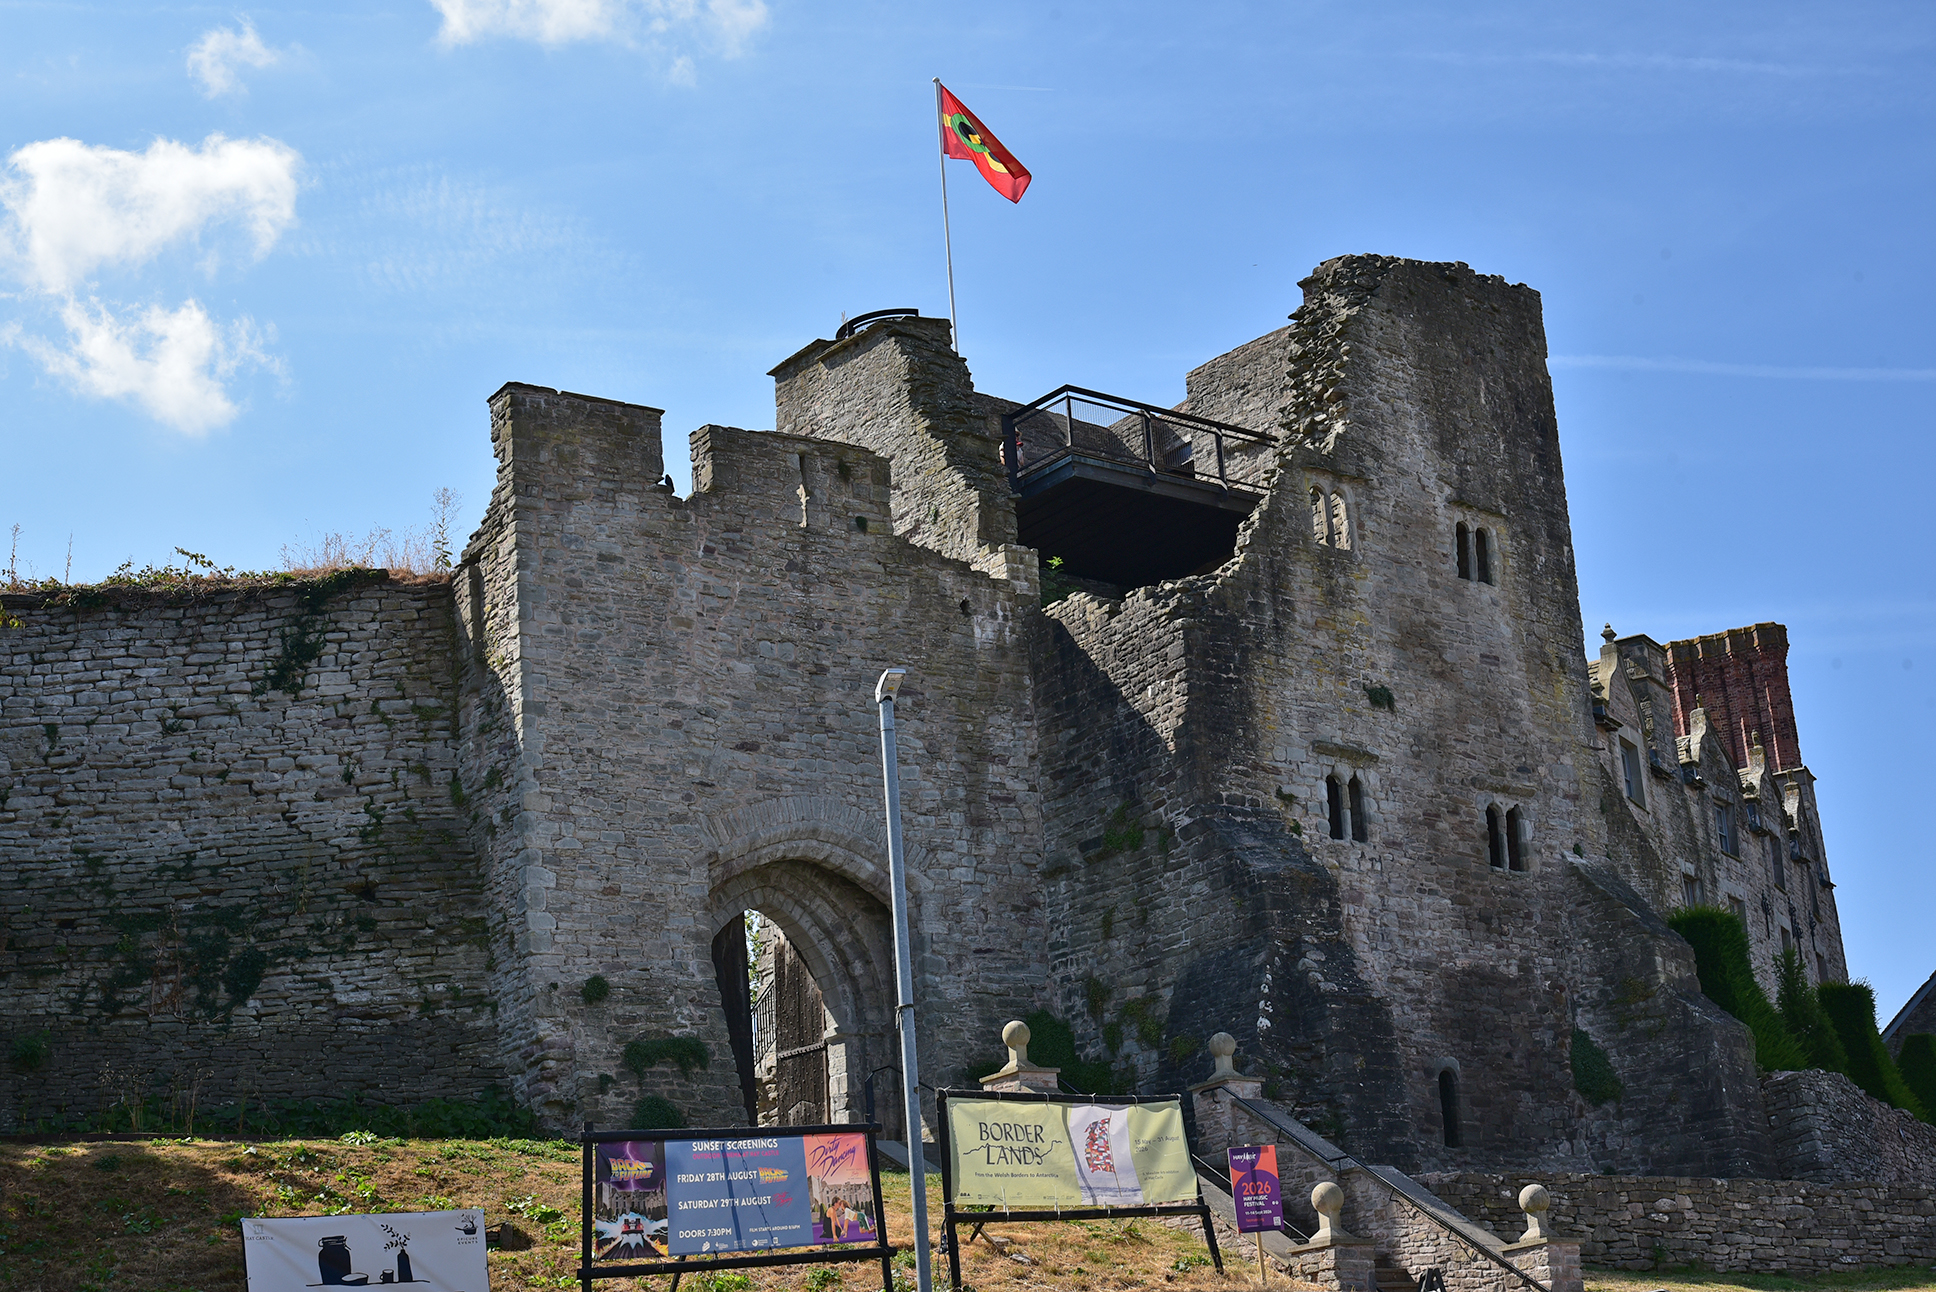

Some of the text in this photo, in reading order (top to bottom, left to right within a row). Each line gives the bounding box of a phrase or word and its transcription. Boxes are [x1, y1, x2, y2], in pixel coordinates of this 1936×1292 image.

[979, 1122, 1045, 1143] BORDER
[692, 1138, 778, 1152] SUNSET SCREENINGS
[692, 1152, 721, 1160] OUTDOOR
[809, 1135, 843, 1170] Dirty
[986, 1145, 1043, 1165] LANDS
[608, 1157, 647, 1171] BACK
[818, 1143, 857, 1180] Dancing
[619, 1170, 653, 1181] FUTURE
[677, 1173, 705, 1183] FRIDAY
[706, 1172, 725, 1182] 28TH
[727, 1170, 757, 1181] AUGUST
[1242, 1181, 1272, 1195] 2026
[678, 1196, 772, 1210] SATURDAY 29TH AUGUST
[679, 1227, 732, 1239] DOORS 7:30PM
